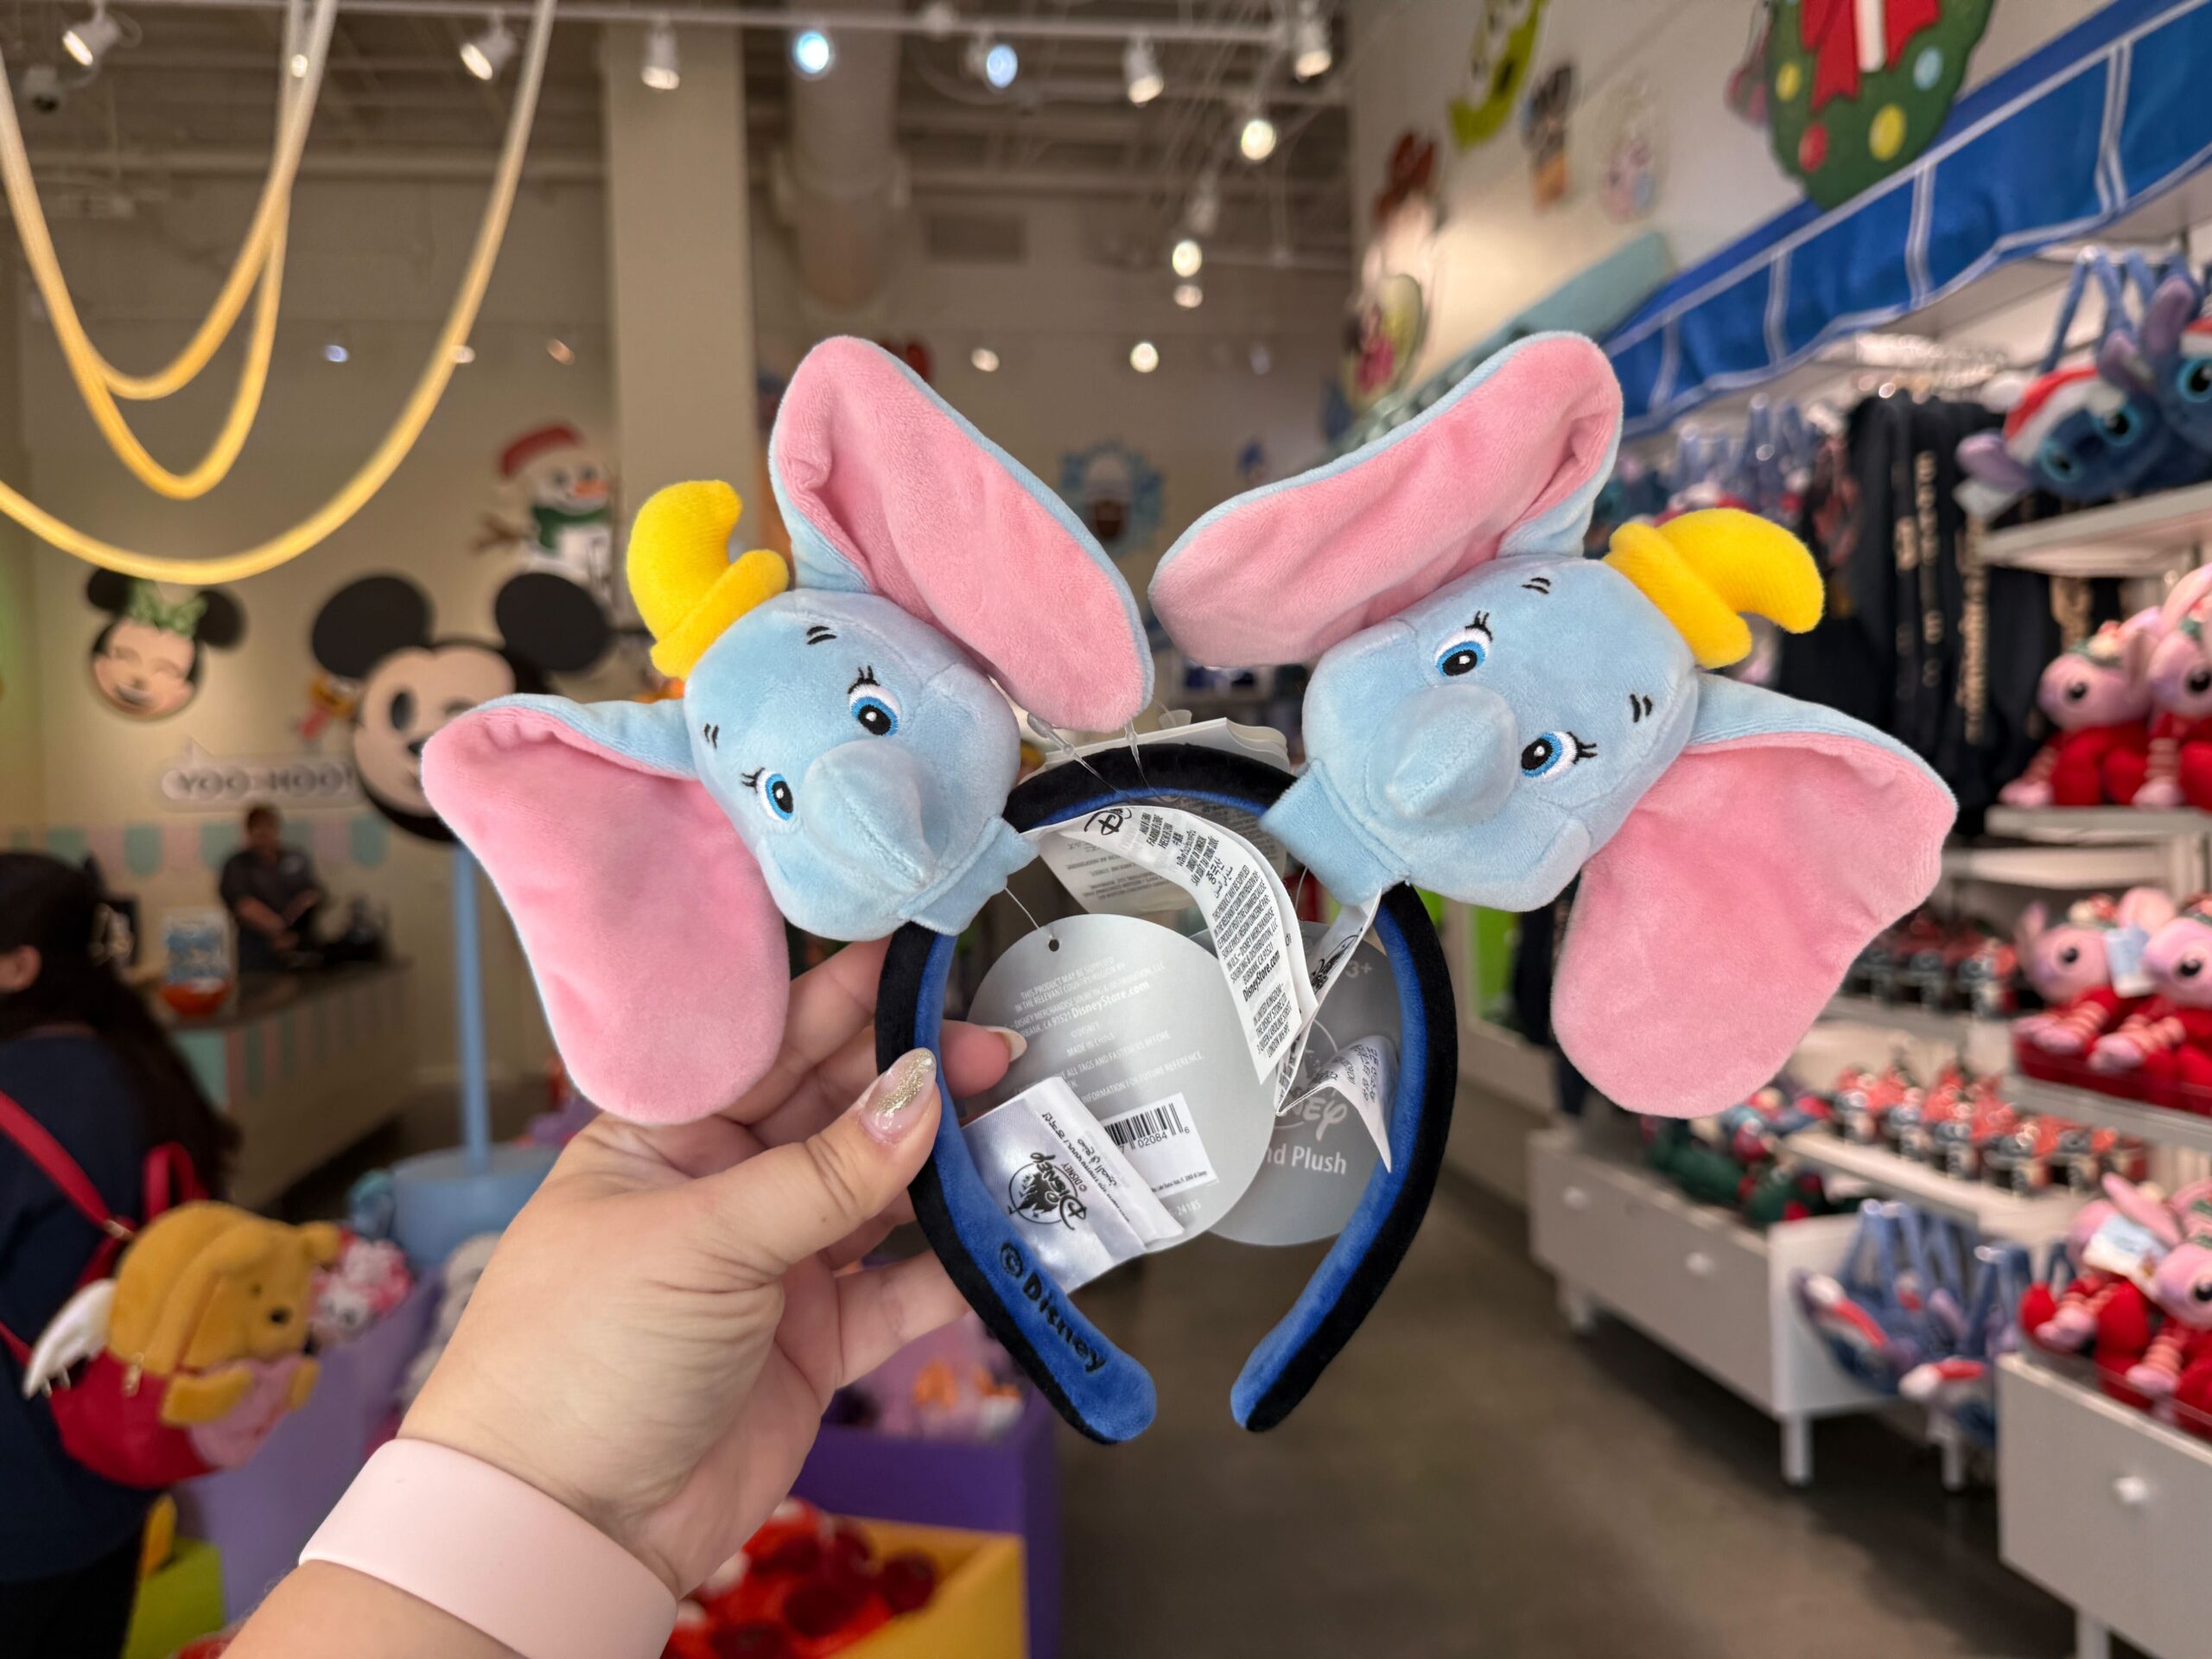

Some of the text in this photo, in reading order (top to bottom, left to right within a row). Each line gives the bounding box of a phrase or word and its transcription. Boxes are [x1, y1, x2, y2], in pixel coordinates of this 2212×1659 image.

[1257, 953, 1264, 965] CA
[1262, 941, 1273, 959] 91521
[1243, 945, 1280, 1004] DisneyStore.com
[1344, 959, 1373, 978] 3+
[1020, 988, 1035, 1001] THIS
[1034, 977, 1064, 995] PRODUCT
[1062, 972, 1076, 984] MAY
[1033, 987, 1064, 1005] RELEVANT
[1033, 1000, 1073, 1021] MERCHANDISE
[1043, 1019, 1052, 1030] CA
[1051, 1011, 1072, 1027] 91521
[1071, 981, 1150, 1019] DisneyStore.com
[1066, 1043, 1086, 1058] MADE
[1066, 1066, 1079, 1077] ALL
[1077, 1060, 1096, 1073] TAGS
[1094, 1053, 1109, 1067] AND
[1108, 1040, 1146, 1062] FASTENERS
[1081, 1078, 1127, 1104] INFORMATION
[1138, 1065, 1166, 1083] FUTURE
[1137, 1131, 1168, 1149] 02084
[1183, 1126, 1191, 1135] 6
[1291, 1145, 1347, 1174] Plush
[1022, 1271, 1107, 1373] Disney
